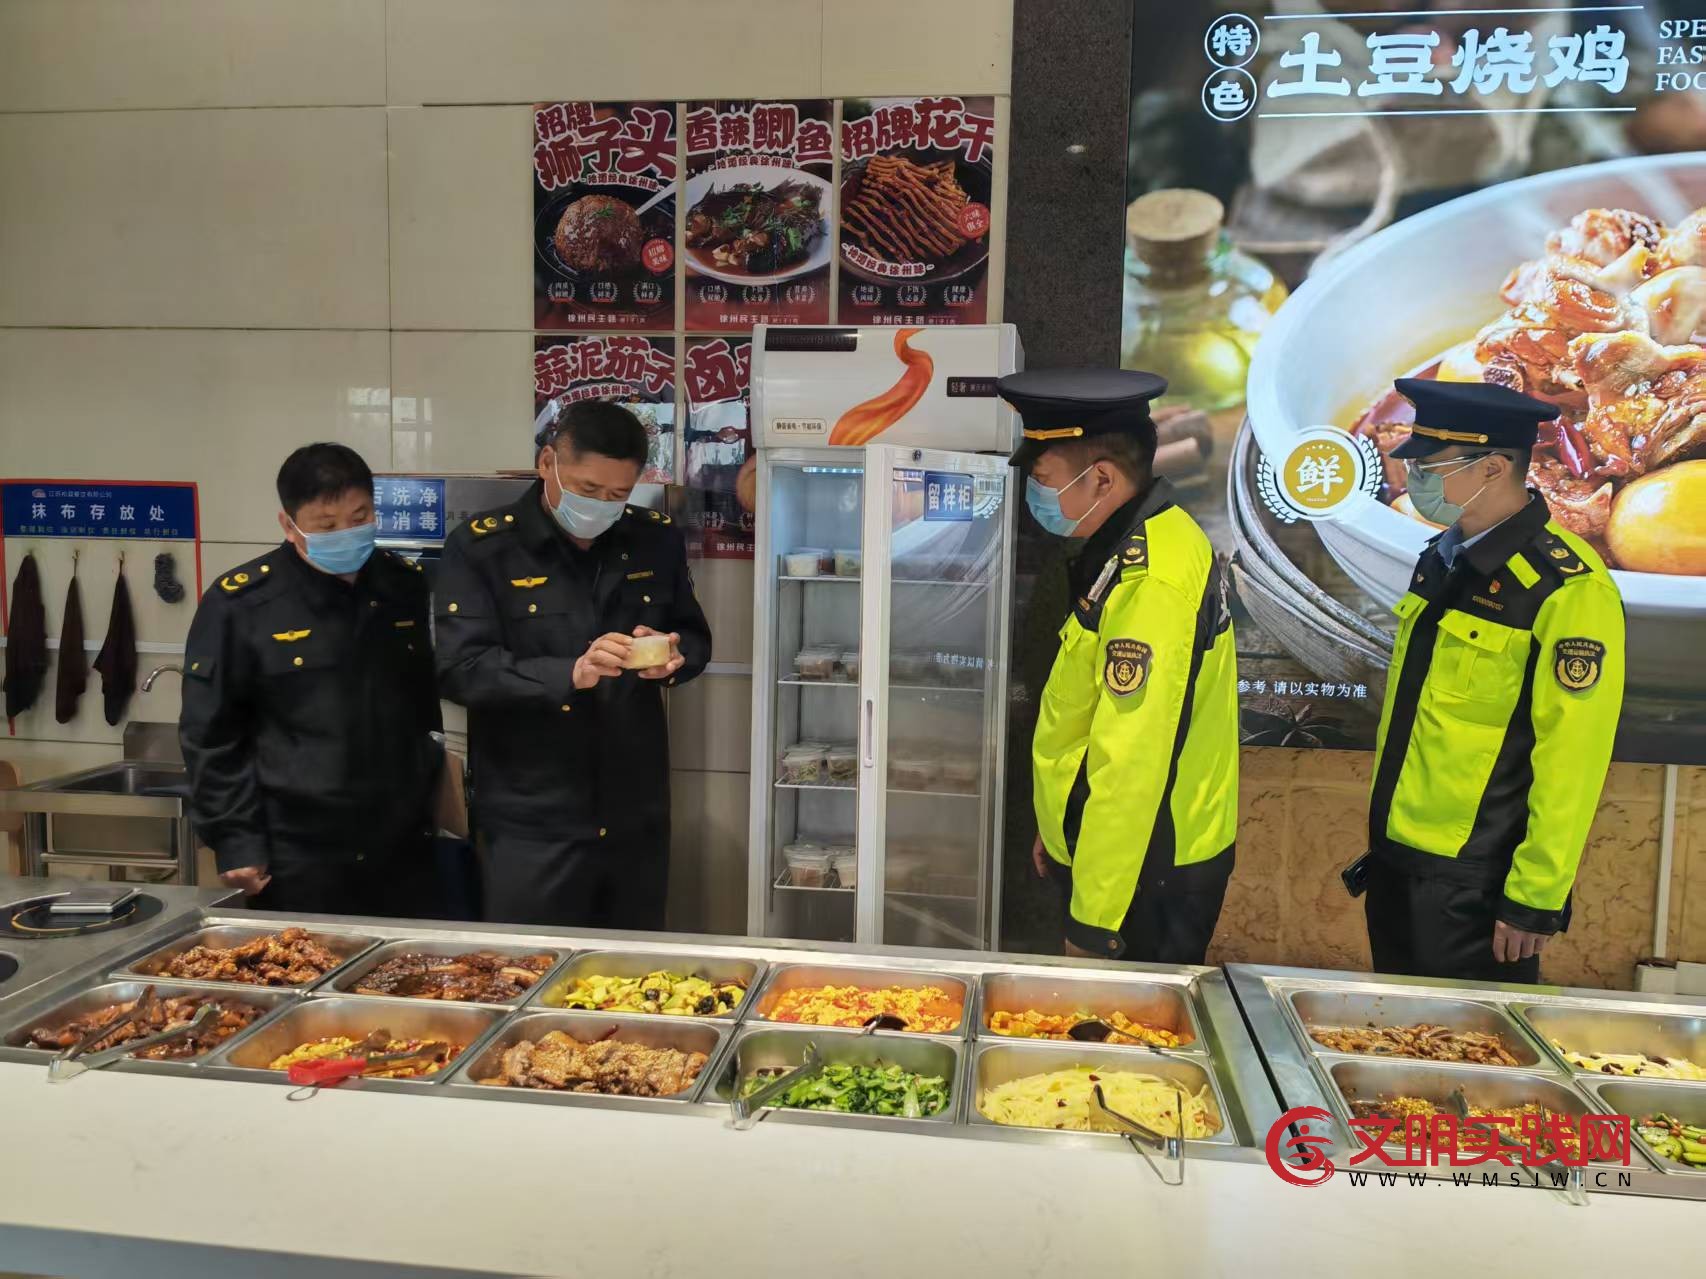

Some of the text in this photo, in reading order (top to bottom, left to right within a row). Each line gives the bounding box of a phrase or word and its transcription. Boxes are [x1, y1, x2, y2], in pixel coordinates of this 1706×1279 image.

[1659, 19, 1706, 38] SPE
[1210, 24, 1252, 111] 特色
[1266, 24, 1630, 98] 土豆烧鸡
[1657, 45, 1706, 64] FAS
[535, 102, 594, 140] 招牌
[686, 103, 833, 164] 香辣鲫鱼
[842, 98, 993, 161] 招牌花干
[534, 107, 677, 190] 狮子头
[849, 245, 925, 276] 地道经典徐州味
[535, 336, 675, 393] 蒜泥茄子
[684, 340, 752, 404] 卤
[1296, 454, 1344, 496] 鲜
[31, 502, 166, 522] 抹布存放处
[928, 482, 971, 512] 留样柜
[1238, 679, 1368, 698] 参考 请以实物为准
